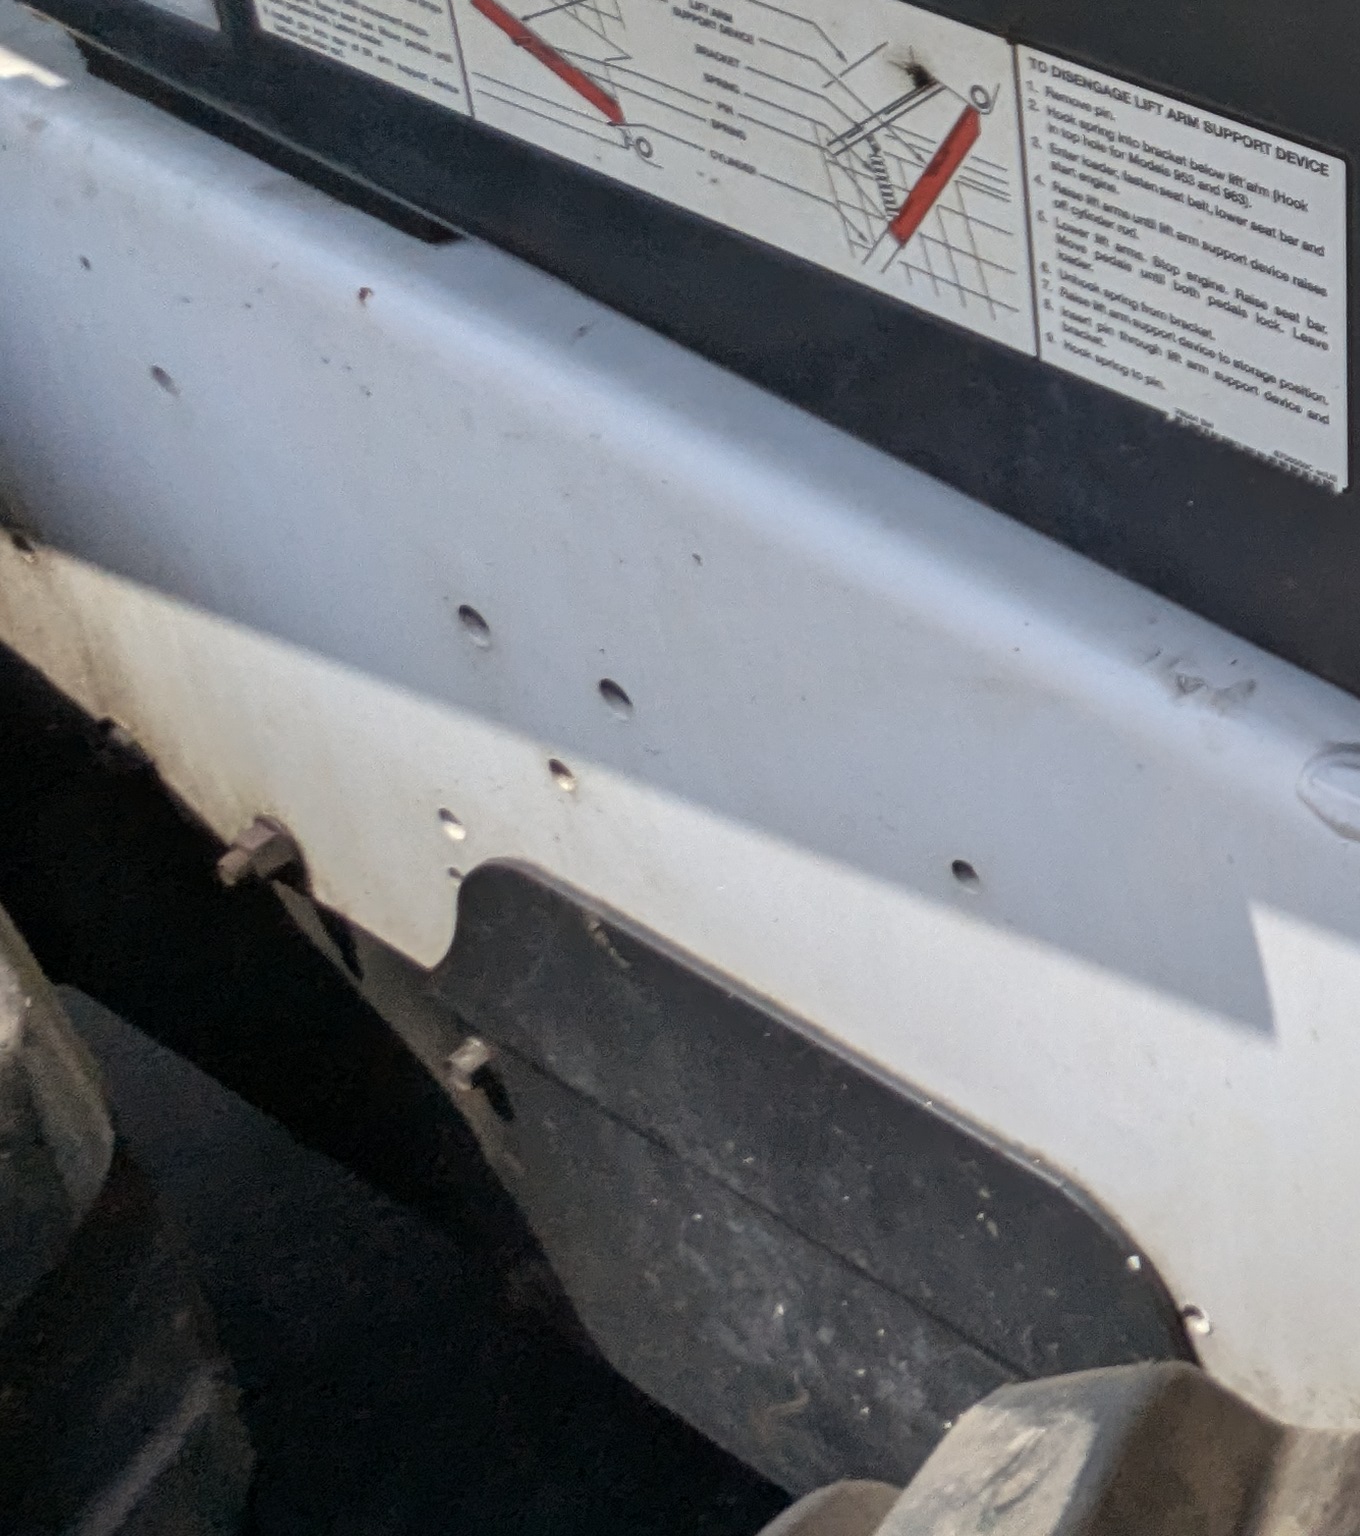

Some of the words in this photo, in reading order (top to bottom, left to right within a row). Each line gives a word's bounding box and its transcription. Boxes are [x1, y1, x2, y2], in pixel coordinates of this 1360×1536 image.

[1028, 97, 1041, 113] 2.
[1079, 119, 1115, 143] spring
[1118, 131, 1140, 149] into
[1142, 140, 1187, 167] bracket
[1189, 157, 1225, 181] below
[1228, 173, 1244, 189] lift
[1246, 181, 1270, 198] arm
[1051, 65, 1132, 105] DISENGAGE
[1134, 95, 1164, 116] LIFT
[1166, 107, 1199, 130] ARM
[1203, 120, 1272, 155] SUPPORT
[1276, 145, 1329, 177] DEVICE
[1083, 133, 1107, 153] hole
[1128, 151, 1171, 177] Models
[1197, 180, 1221, 197] and
[1215, 204, 1248, 227] lower
[1250, 221, 1277, 239] seat
[1280, 229, 1299, 247] bar
[1302, 240, 1325, 257] and
[1202, 240, 1248, 266] support
[1250, 258, 1290, 283] device
[1208, 295, 1248, 319] pedals
[1293, 326, 1329, 351] Leave
[1275, 305, 1300, 324] seat
[1132, 318, 1177, 343] support
[1178, 336, 1216, 359] device
[1218, 351, 1231, 365] to
[1233, 359, 1277, 384] storage
[1280, 378, 1329, 406] position.
[1214, 370, 1259, 396] support
[1264, 390, 1303, 414] device
[1307, 409, 1330, 425] and
